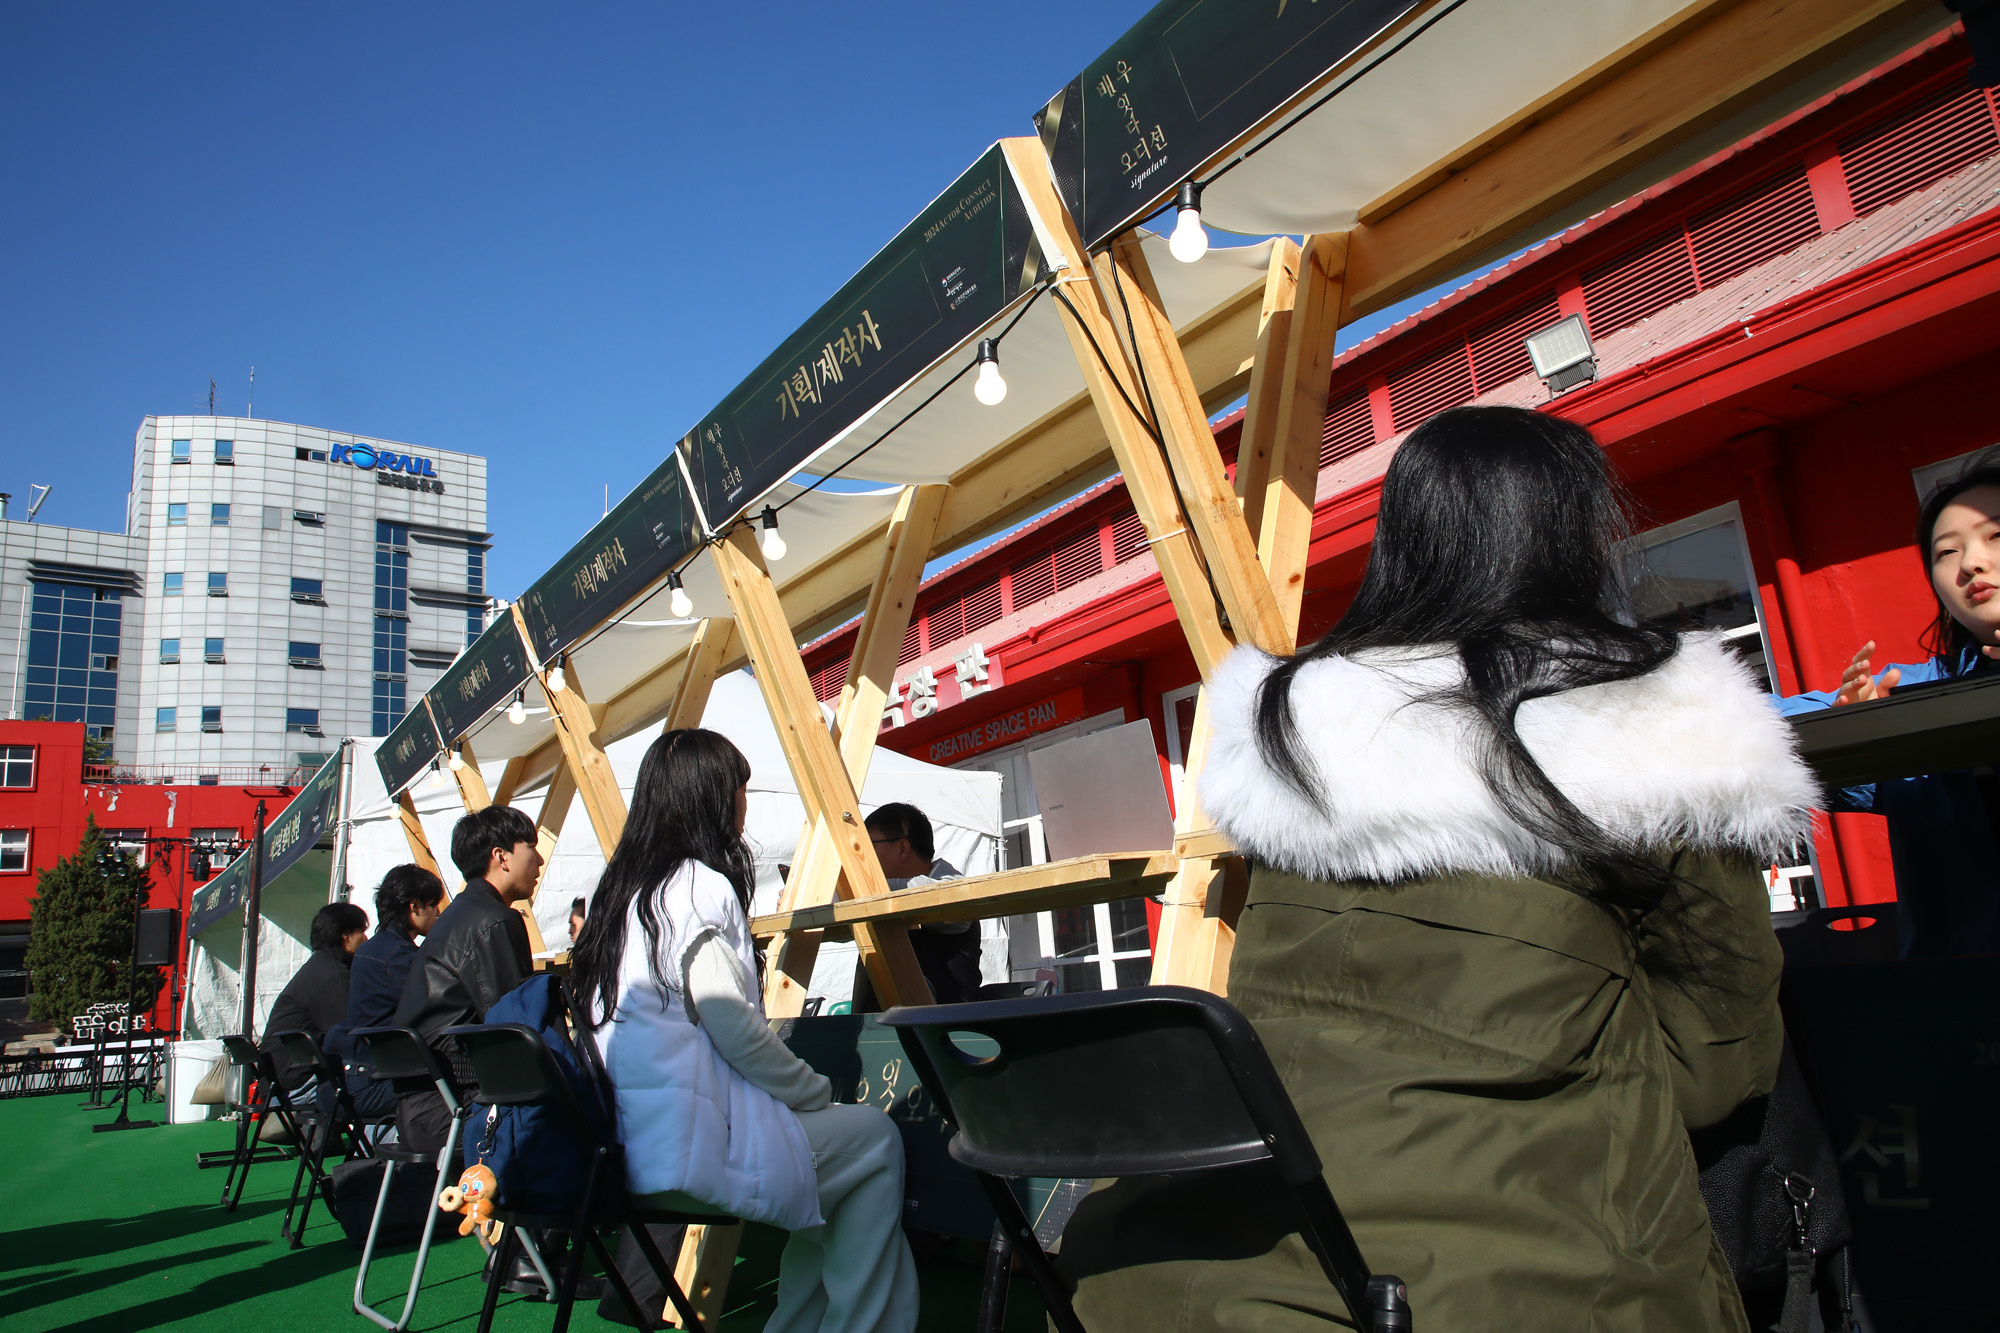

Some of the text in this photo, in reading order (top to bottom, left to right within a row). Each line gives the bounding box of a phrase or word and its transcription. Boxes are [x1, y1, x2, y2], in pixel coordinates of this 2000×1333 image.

[1096, 61, 1132, 97] 배우
[1117, 93, 1140, 135] 잇다
[1121, 125, 1168, 175] 오디션
[1130, 155, 1168, 190] signature
[965, 191, 996, 222] AUDITION
[775, 310, 882, 422] 기획/제작사
[330, 443, 437, 477] KORAIL
[571, 537, 627, 600] 기획/제작사
[952, 643, 991, 700] 판
[930, 700, 1057, 761] CREATIVE SPACE PAN
